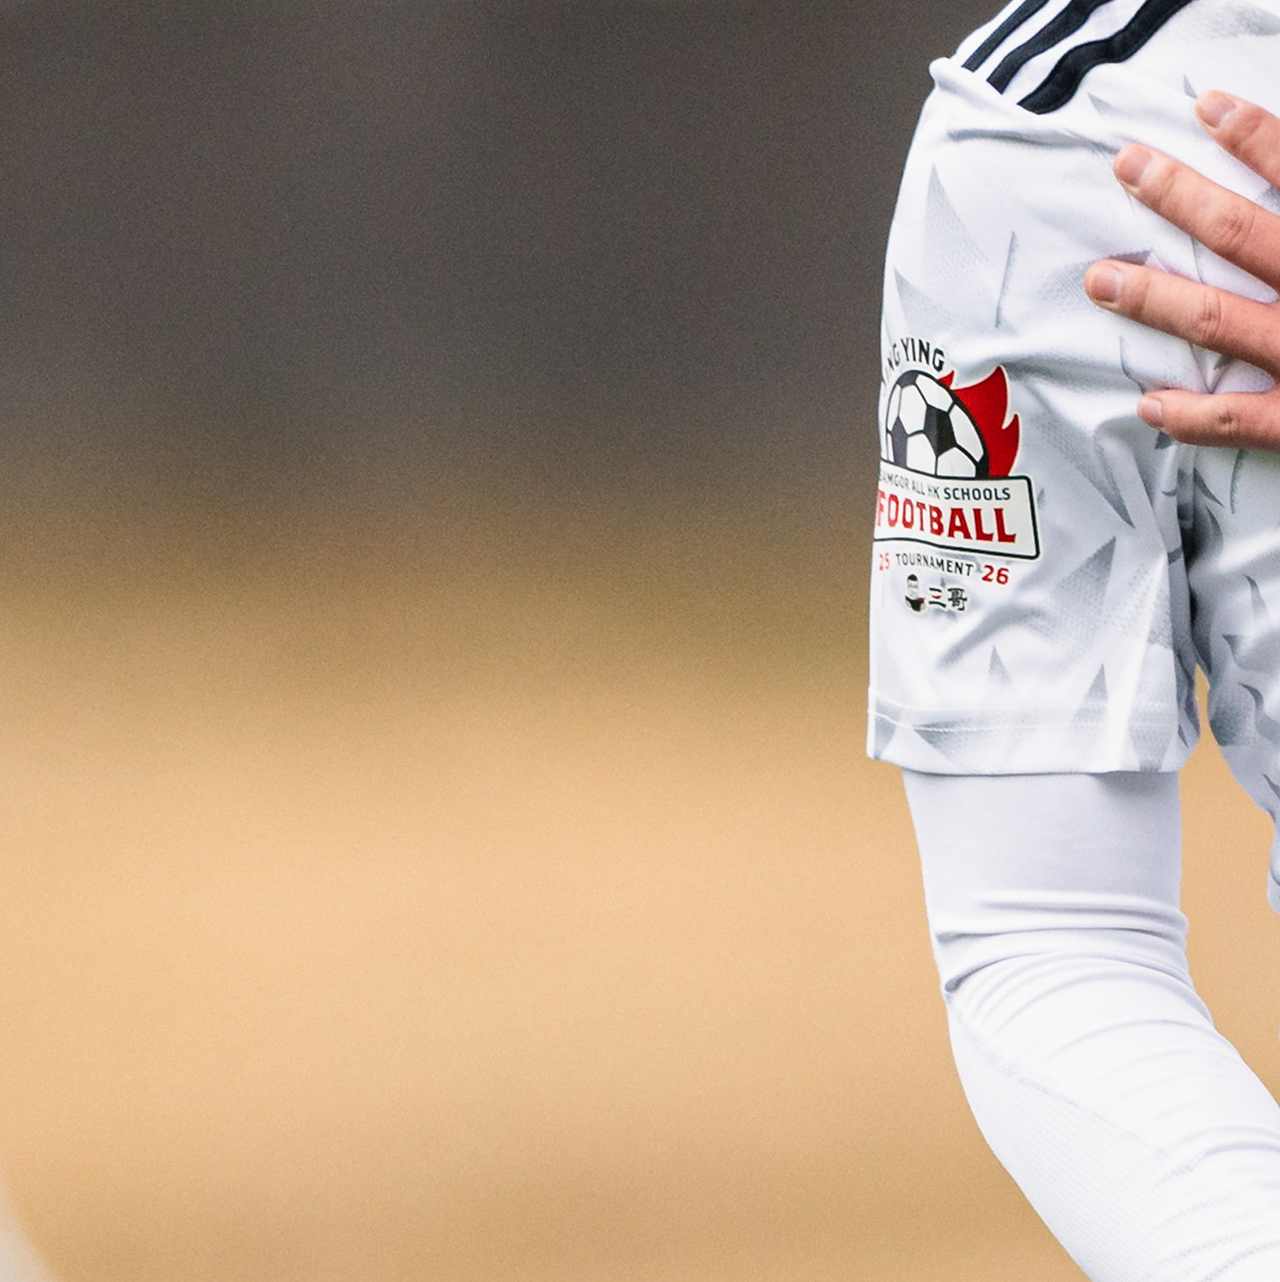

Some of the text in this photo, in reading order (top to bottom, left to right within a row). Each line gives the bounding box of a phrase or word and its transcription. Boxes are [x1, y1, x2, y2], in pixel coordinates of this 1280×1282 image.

[900, 336, 945, 373] YING
[911, 479, 926, 496] ALL
[943, 486, 1011, 502] SCHOOLS
[876, 487, 1017, 544] FOOTBALL
[878, 552, 1010, 586] 25 TOURNAMENT 26
[928, 586, 969, 612] 三哥
